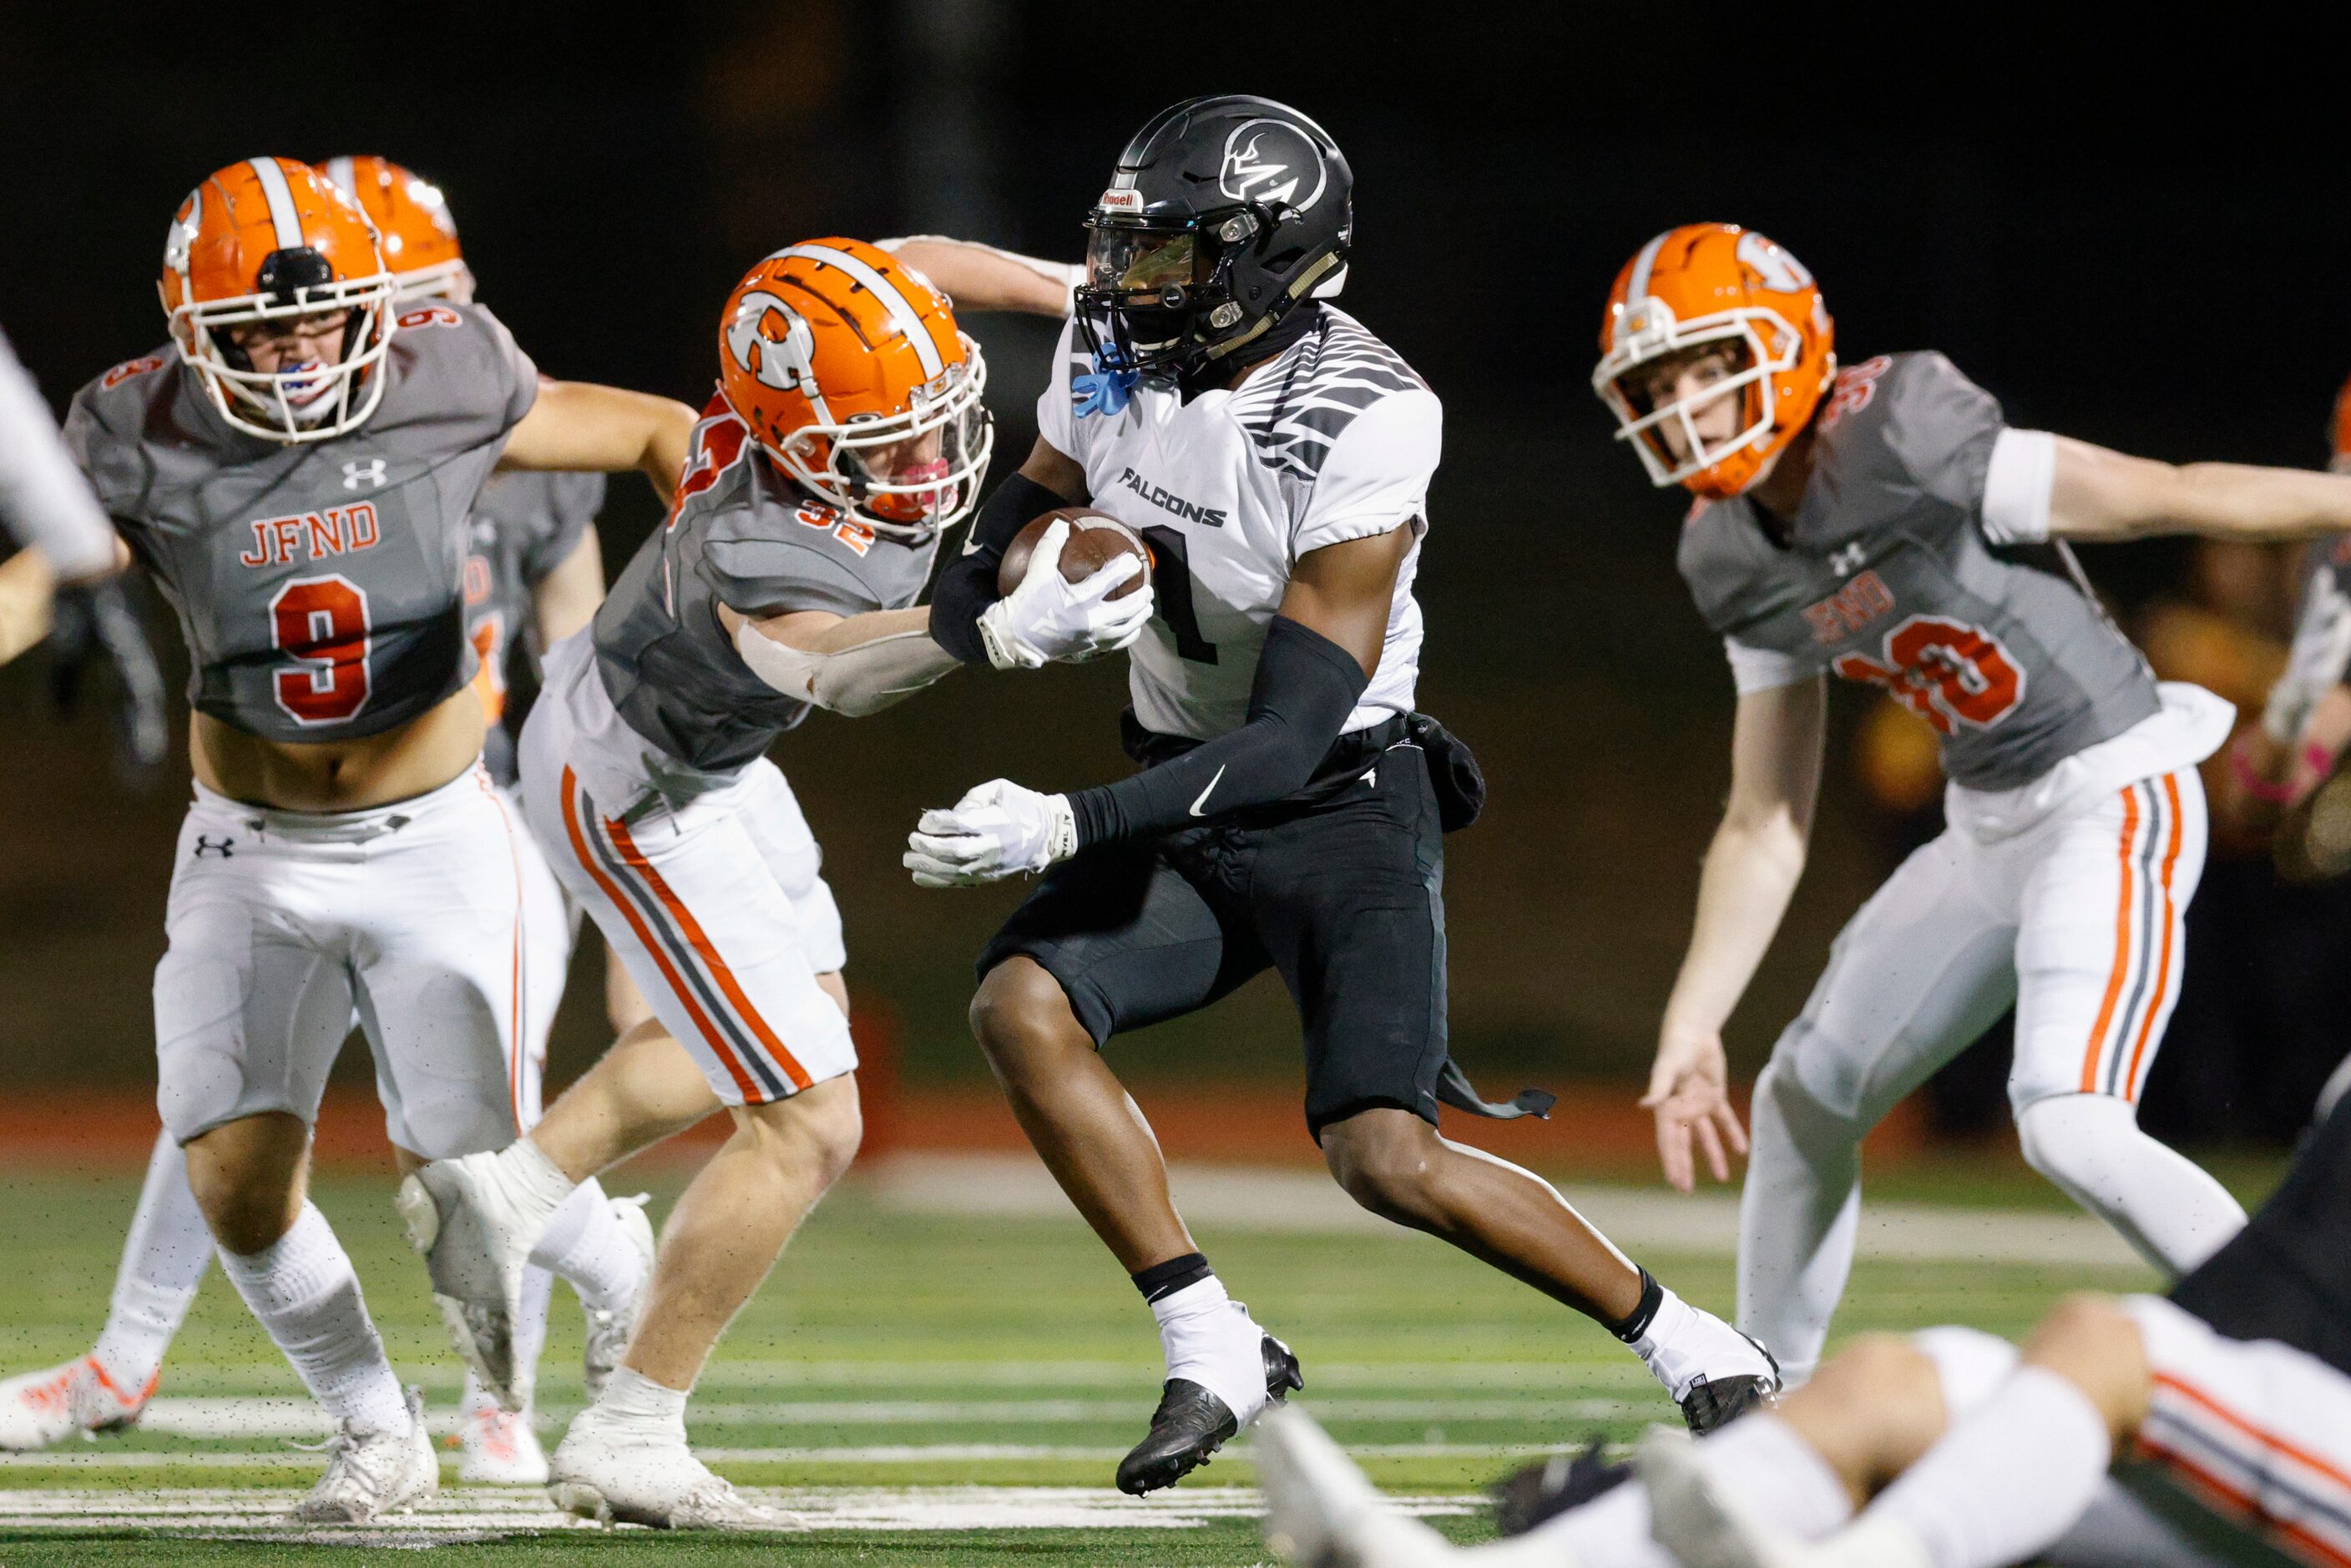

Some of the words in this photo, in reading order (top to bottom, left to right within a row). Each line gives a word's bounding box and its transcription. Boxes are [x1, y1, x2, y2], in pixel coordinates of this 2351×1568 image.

[240, 500, 381, 568] JFND
[1117, 467, 1227, 529] FALCONS
[1141, 524, 1219, 665] 1
[267, 573, 372, 727] 9
